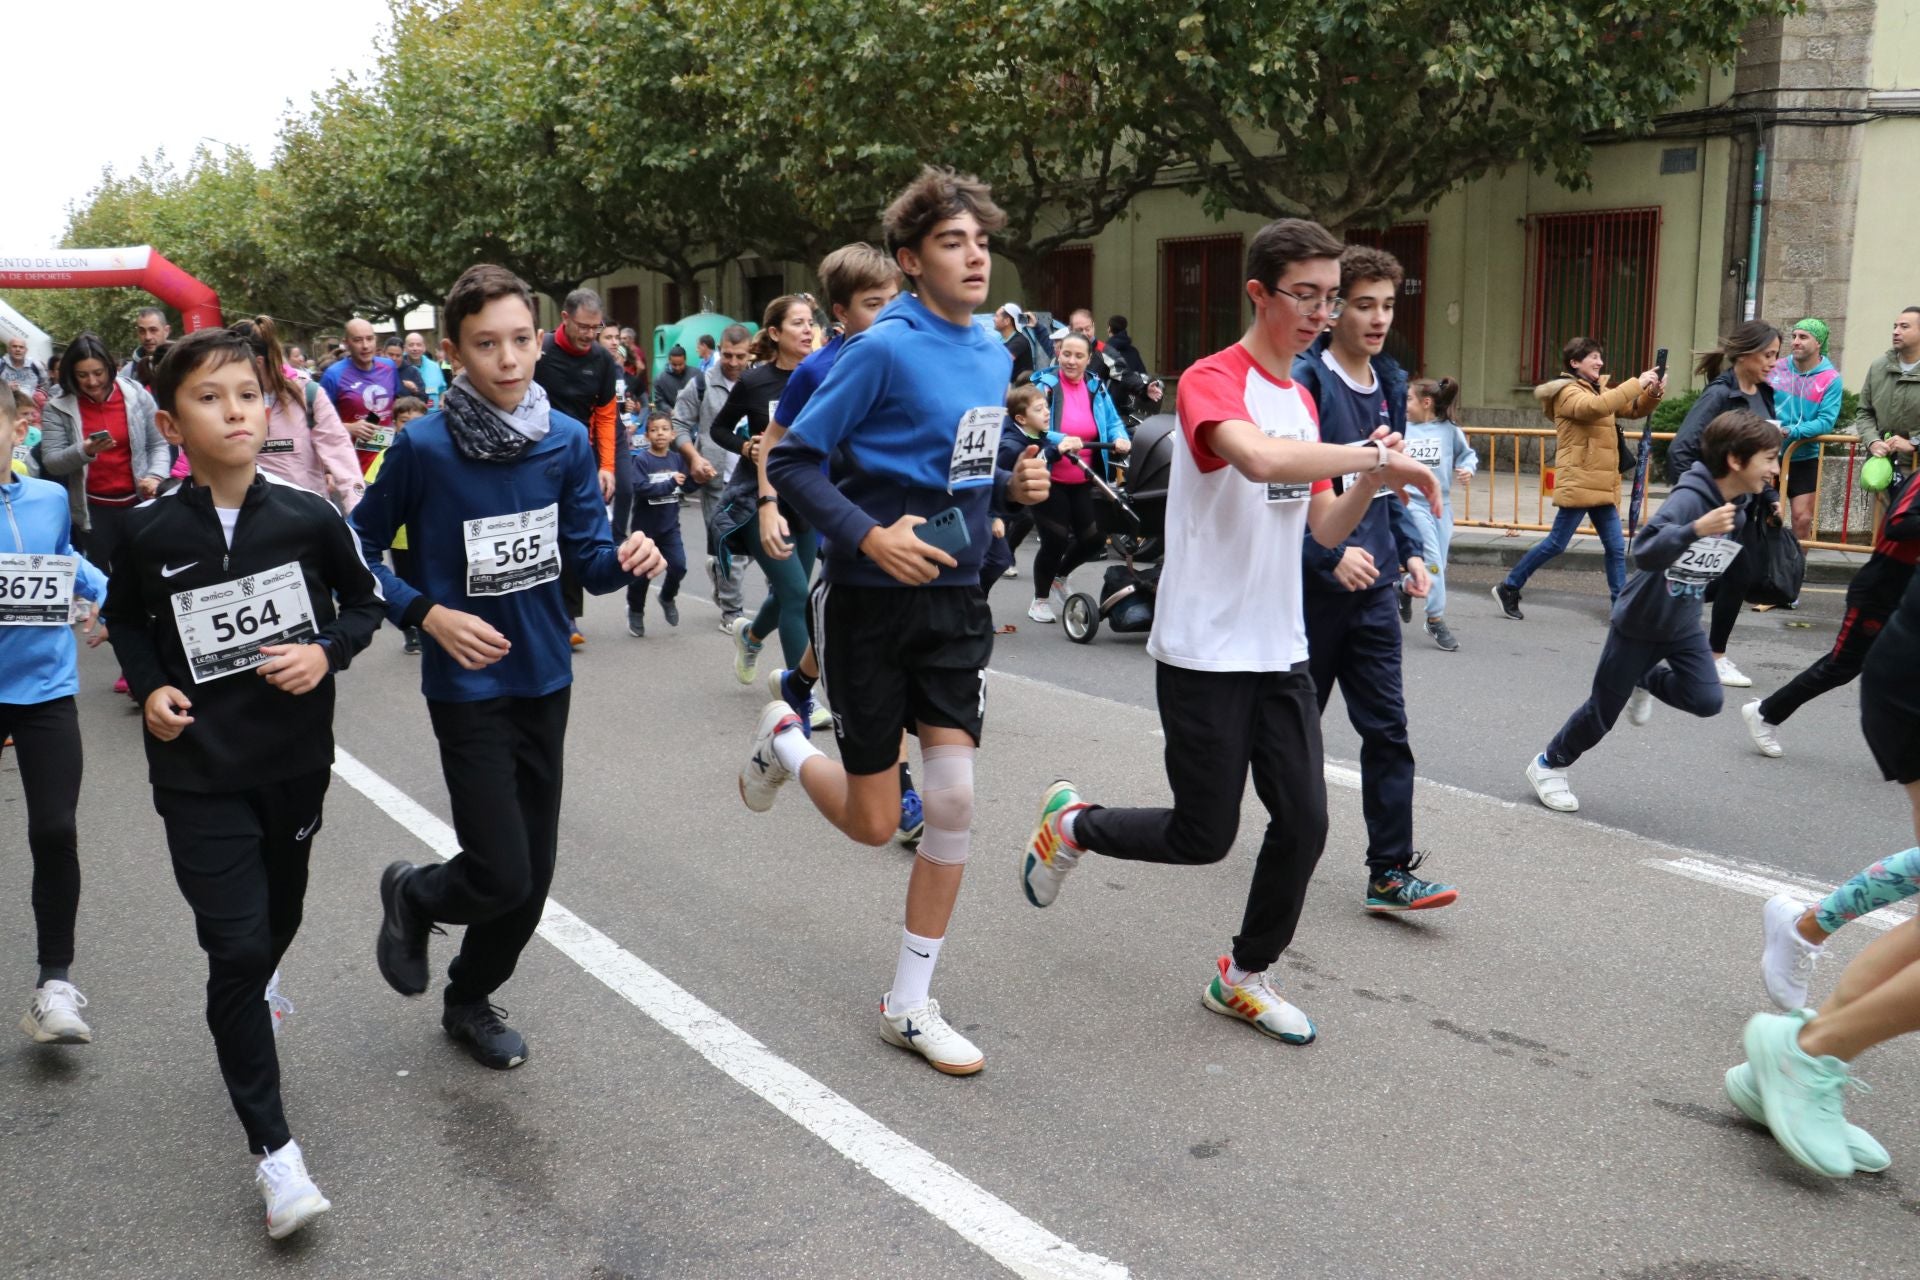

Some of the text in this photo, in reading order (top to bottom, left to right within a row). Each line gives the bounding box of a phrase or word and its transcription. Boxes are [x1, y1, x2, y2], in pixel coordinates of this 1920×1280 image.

[36, 257, 51, 268] DE
[9, 272, 22, 280] DE
[25, 272, 72, 280] DEPORTES
[1410, 447, 1439, 458] 2427
[493, 534, 541, 567] 565
[1682, 549, 1722, 568] 2406
[200, 590, 234, 602] emico
[262, 571, 294, 586] emico
[211, 599, 281, 643] 564
